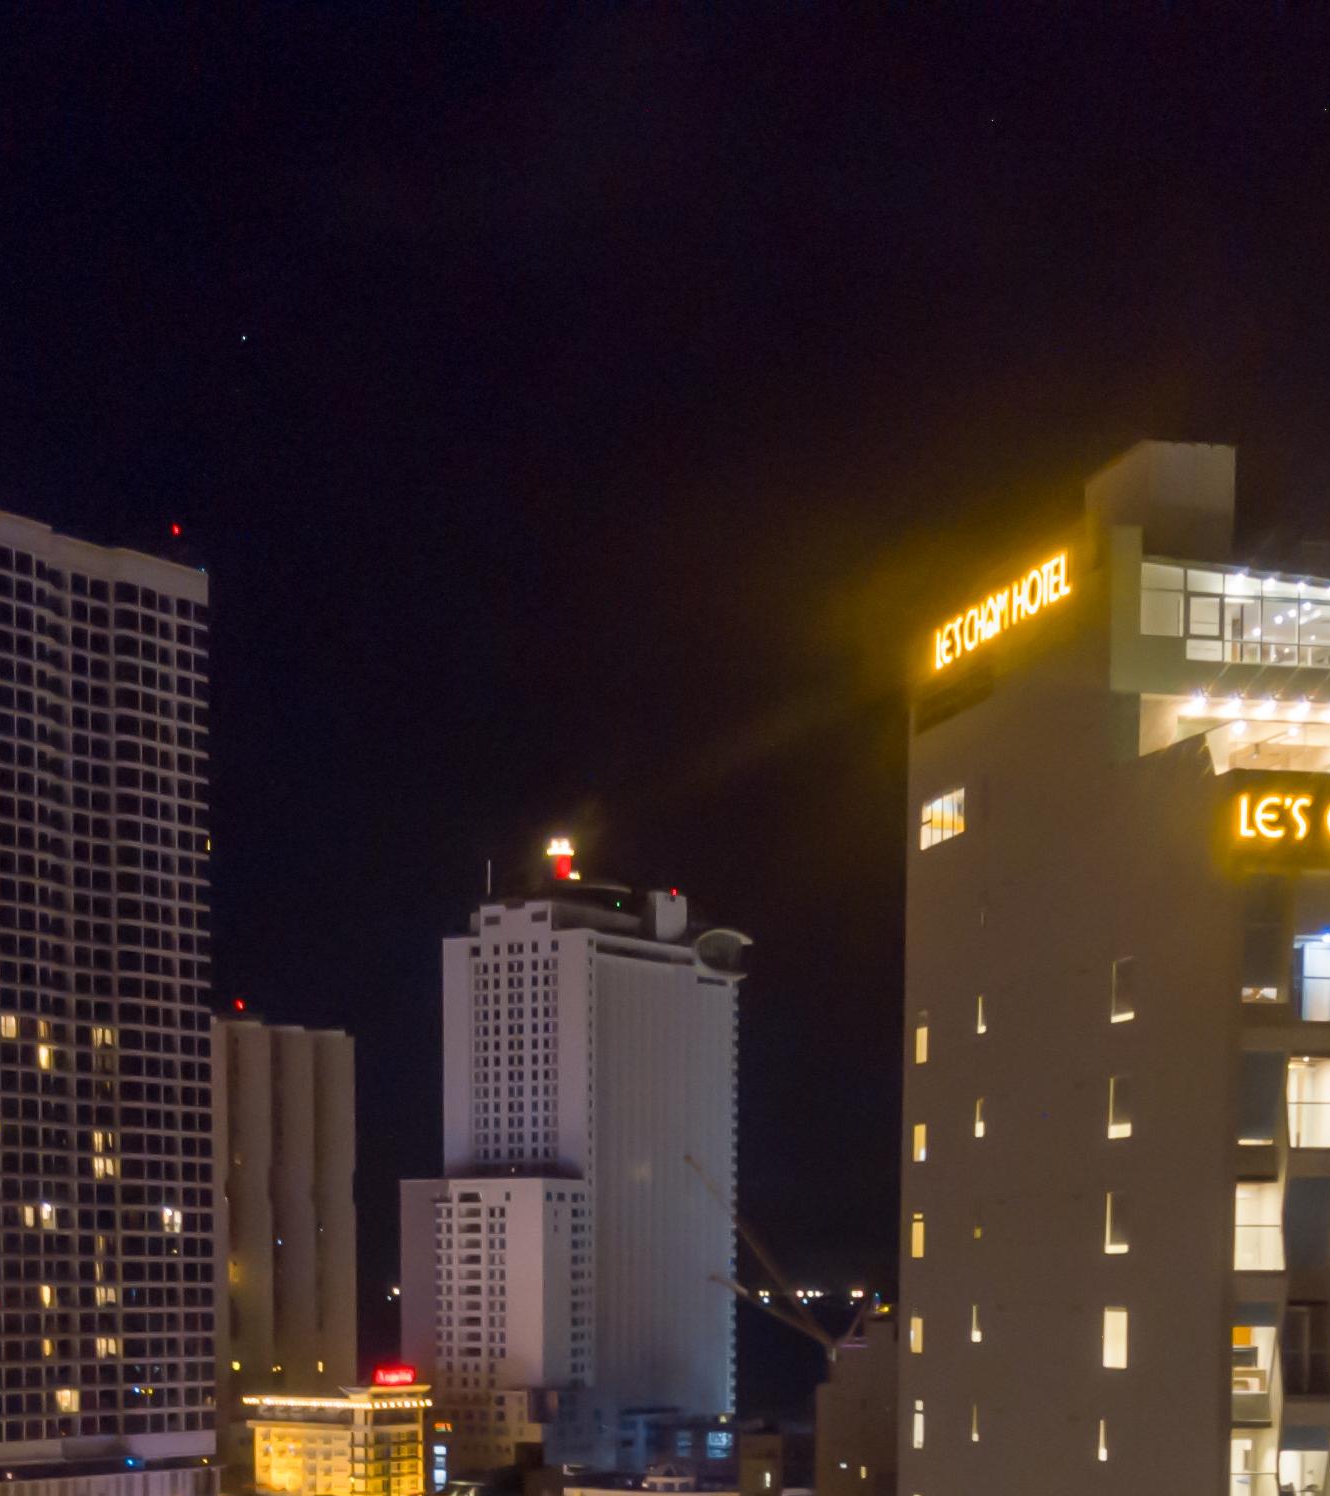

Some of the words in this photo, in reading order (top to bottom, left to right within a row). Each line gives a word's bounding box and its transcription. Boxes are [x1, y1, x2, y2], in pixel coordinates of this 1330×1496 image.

[964, 587, 1010, 652] CHAM
[1012, 551, 1072, 625] HOTEL
[1236, 792, 1312, 841] LE'S
